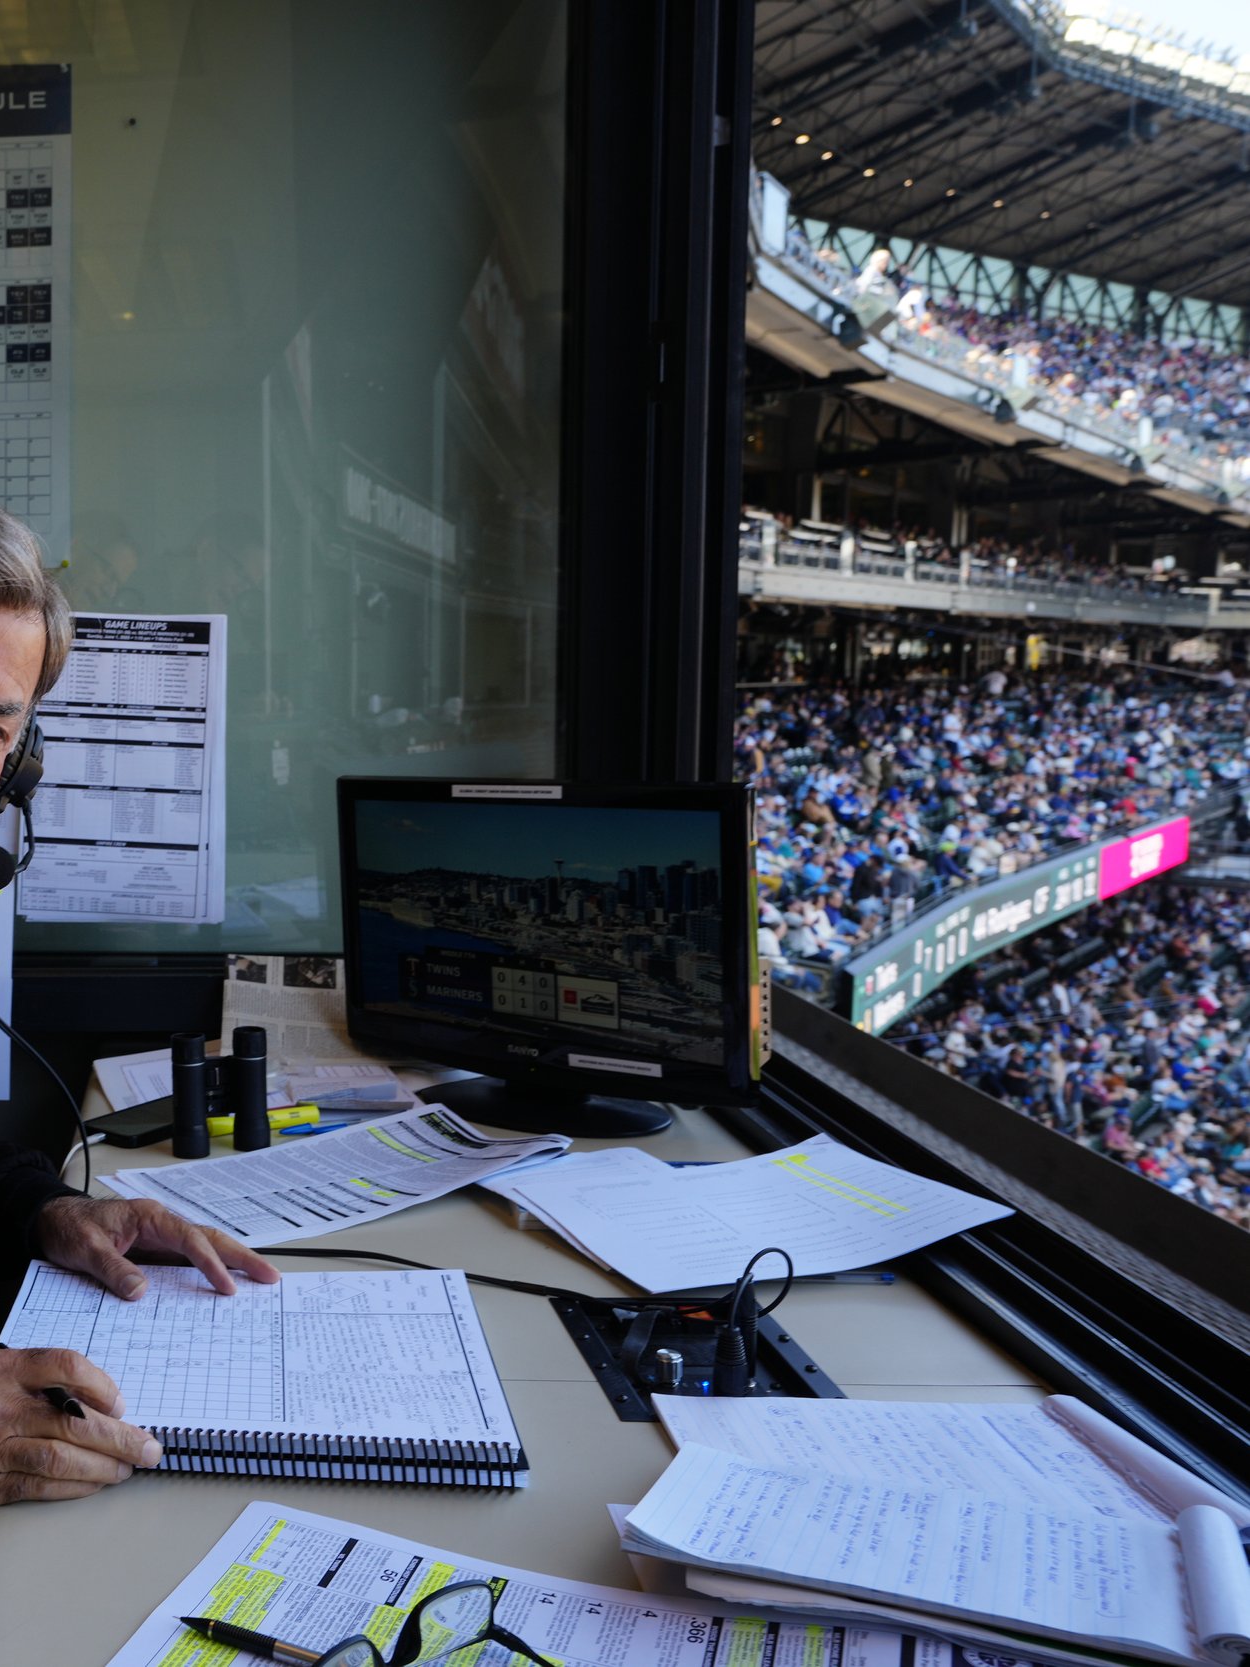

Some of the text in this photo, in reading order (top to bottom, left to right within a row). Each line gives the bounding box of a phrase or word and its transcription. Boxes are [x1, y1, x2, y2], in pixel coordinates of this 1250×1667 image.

[104, 620, 168, 631] GAME LINEUPS
[426, 963, 461, 977] TWINS
[497, 971, 548, 988] 0 4 0
[426, 985, 484, 1002] MARINERS
[498, 994, 548, 1011] 0 1 0
[507, 1043, 539, 1057] SANYO
[379, 1568, 398, 1584] 56
[538, 1592, 557, 1606] 14
[585, 1602, 604, 1616] 14
[642, 1610, 658, 1619] 4
[687, 1616, 707, 1644] .366
